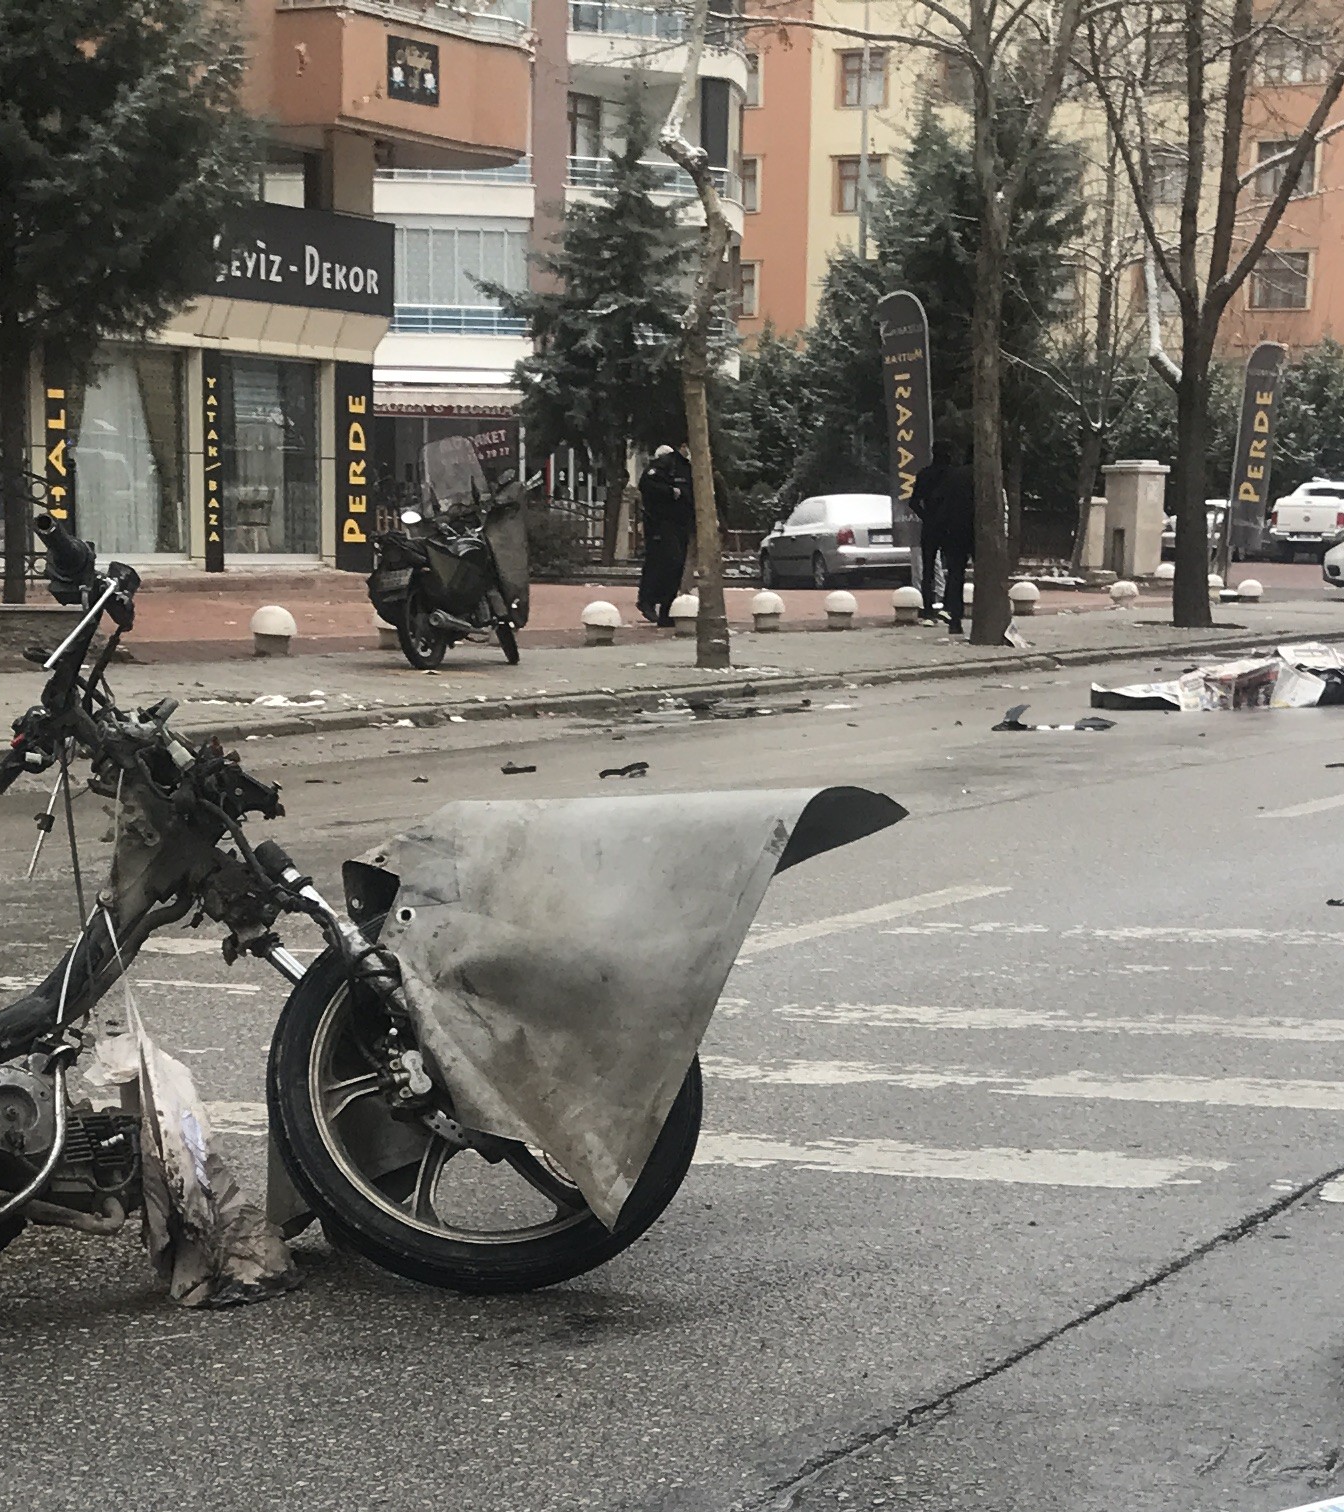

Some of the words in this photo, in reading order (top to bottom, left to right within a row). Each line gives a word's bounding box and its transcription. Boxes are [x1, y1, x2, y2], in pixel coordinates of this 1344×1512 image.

[304, 244, 379, 296] DEKOR
[343, 395, 366, 543] PERDE
[1237, 389, 1273, 503] PERDE
